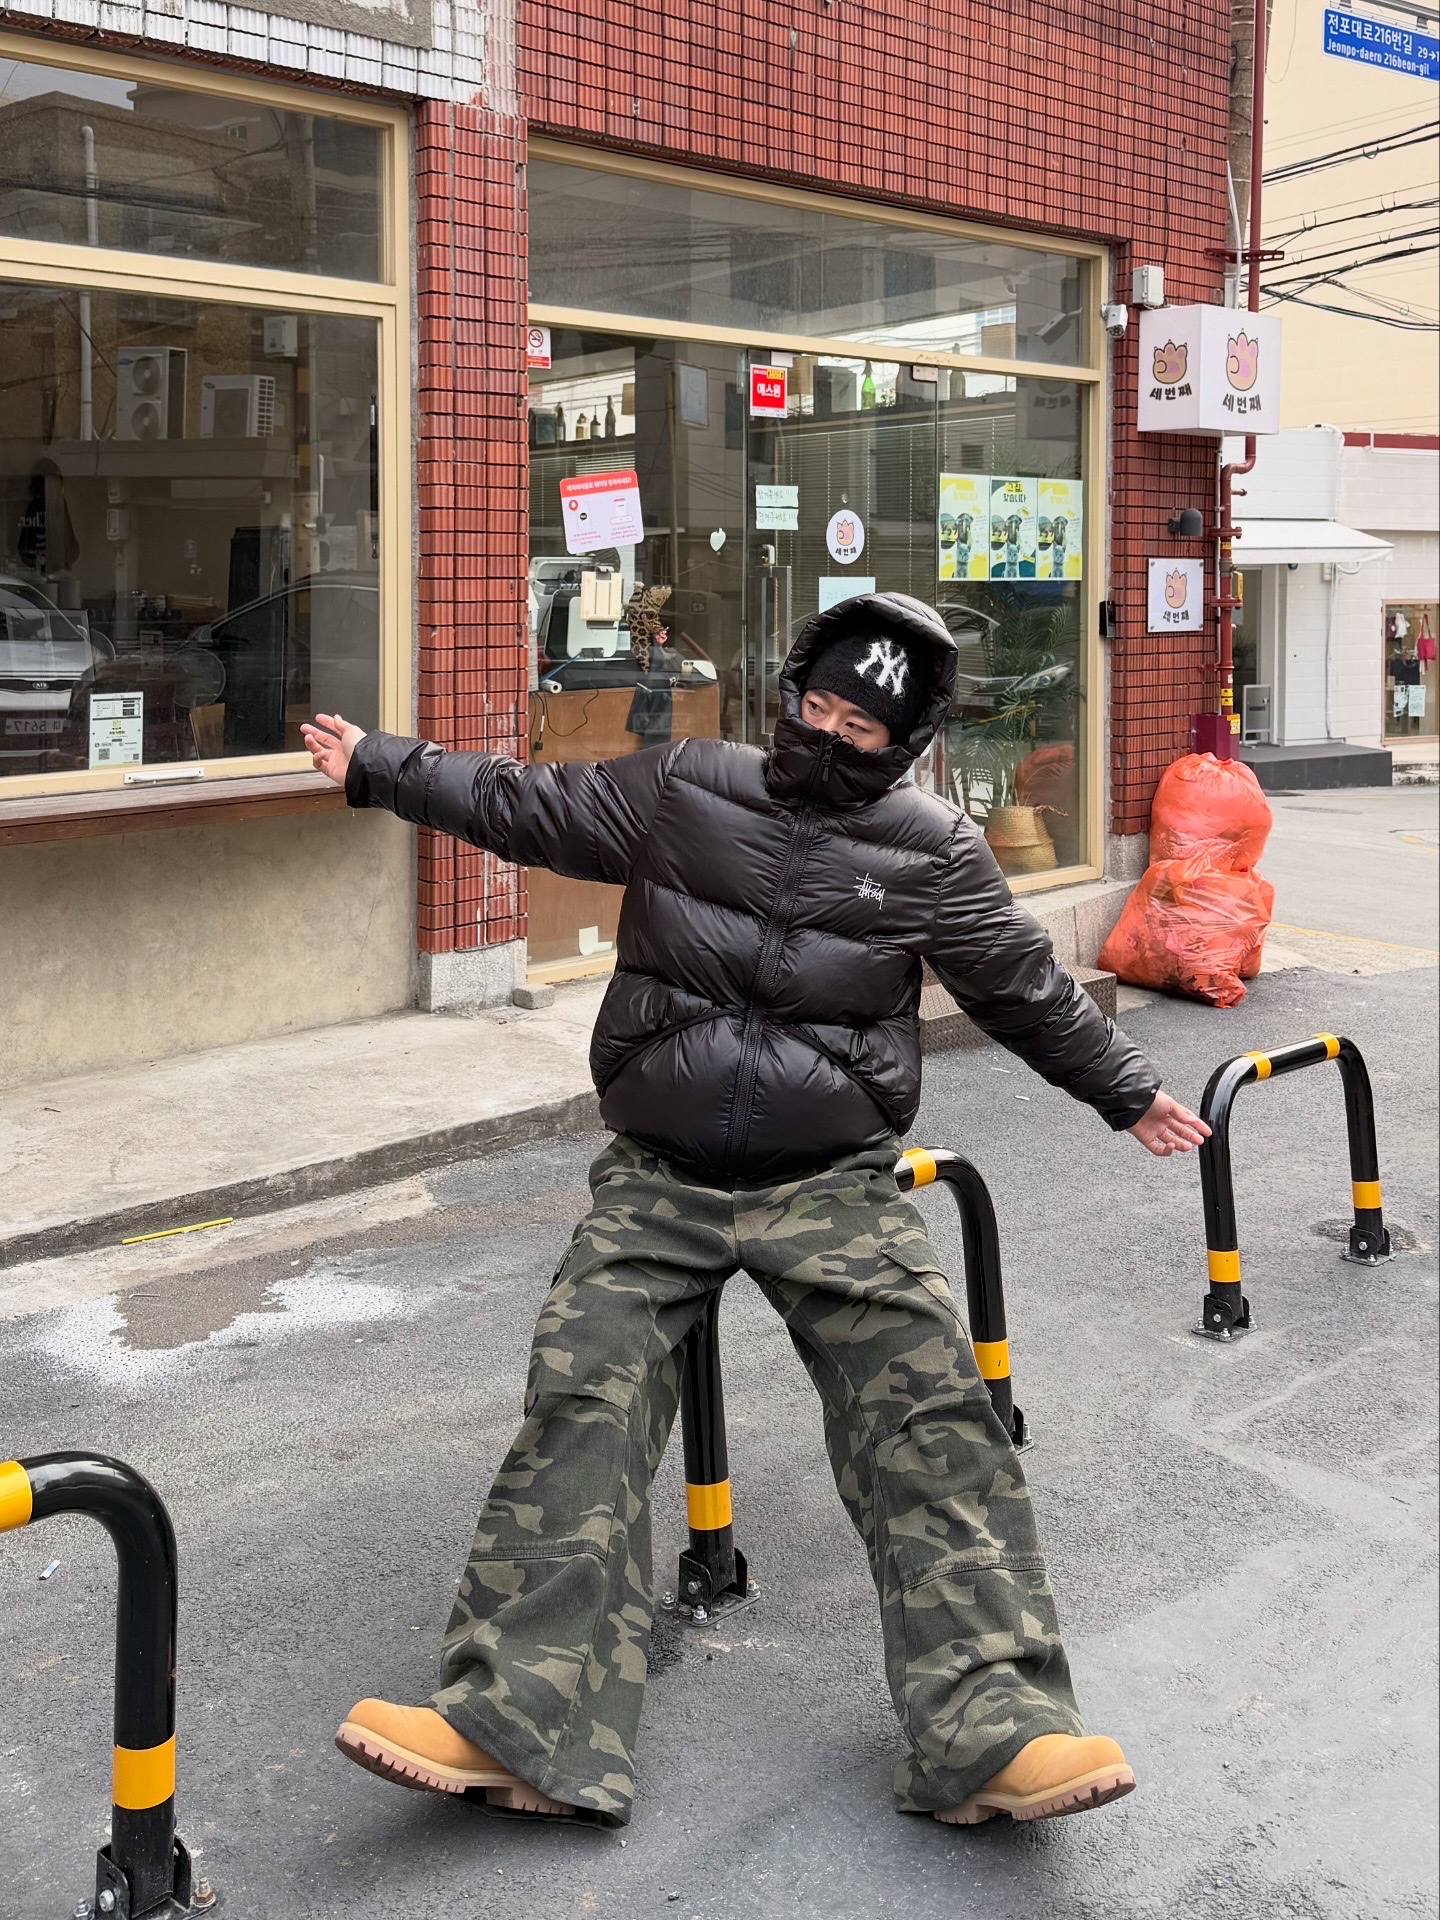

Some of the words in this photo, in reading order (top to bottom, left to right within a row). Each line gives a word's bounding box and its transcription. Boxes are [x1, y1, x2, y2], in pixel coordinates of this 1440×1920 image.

[1327, 13, 1413, 55] 전포대로216번길
[1326, 38, 1382, 63] Jeonpo-daero
[1383, 53, 1429, 76] 216beon-gil
[757, 383, 781, 398] 에스원
[1149, 382, 1193, 401] 세번째
[1222, 393, 1262, 414] 세번째
[1162, 609, 1190, 623] 세번째
[853, 639, 909, 699] NY
